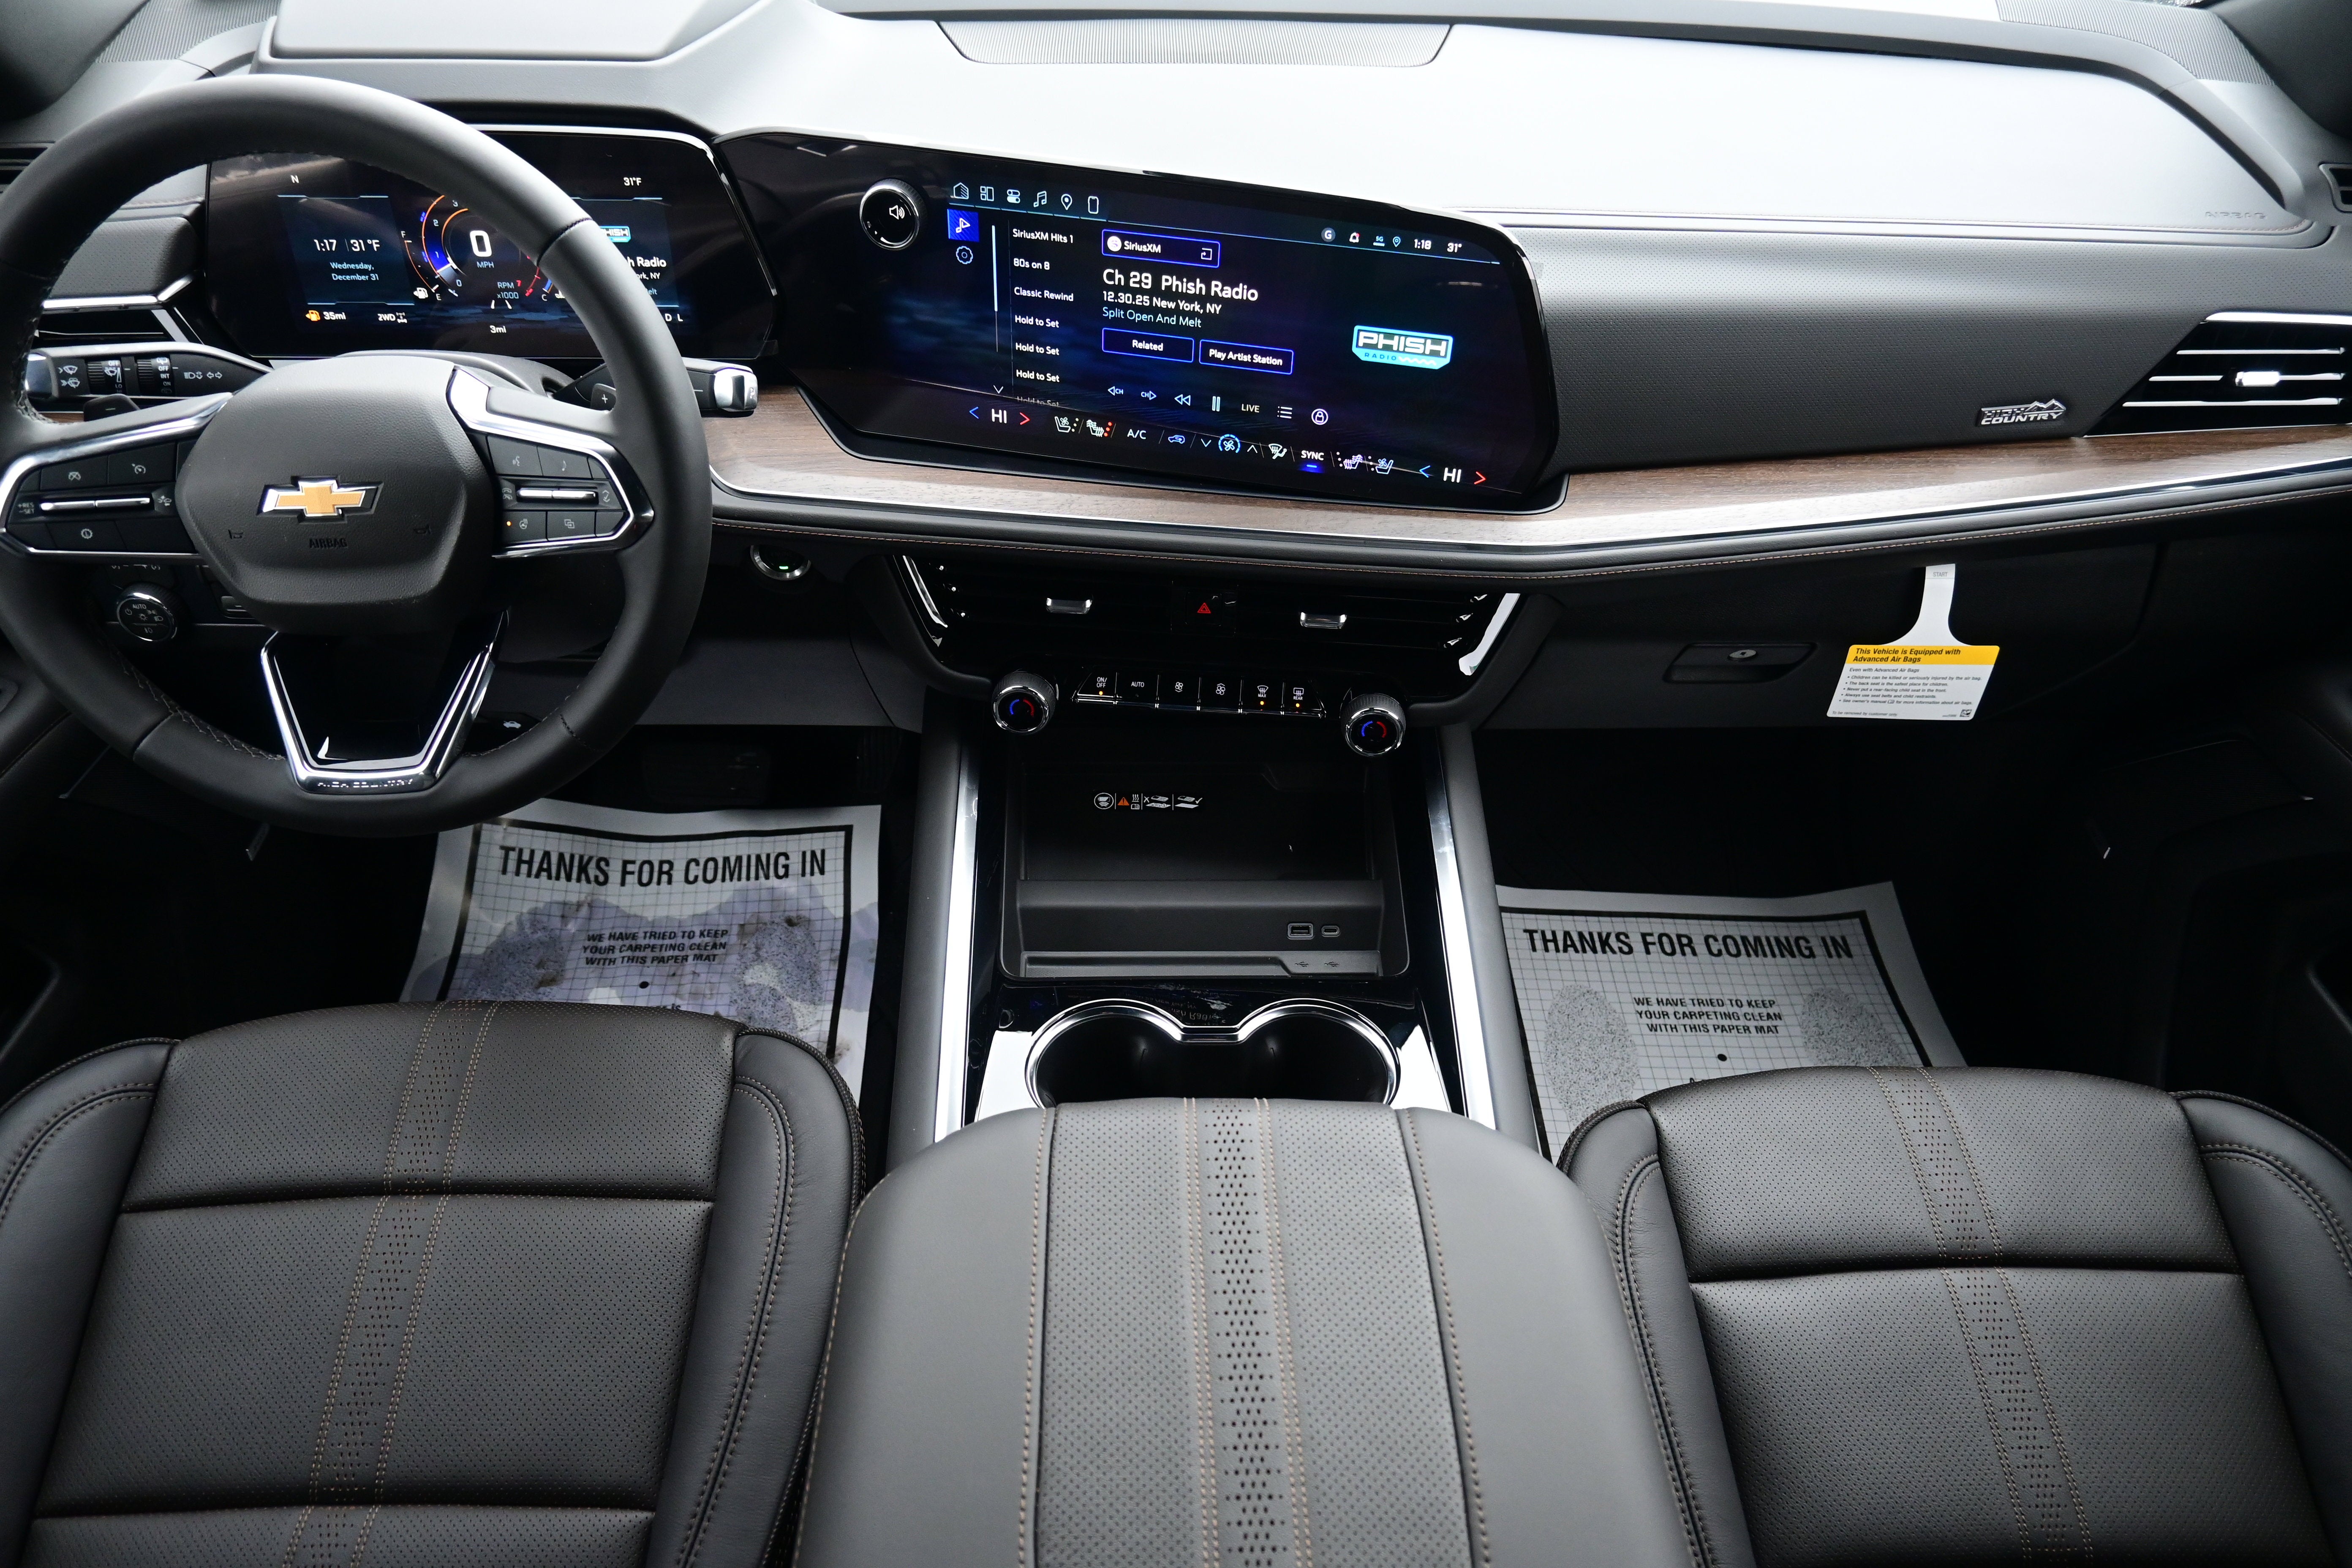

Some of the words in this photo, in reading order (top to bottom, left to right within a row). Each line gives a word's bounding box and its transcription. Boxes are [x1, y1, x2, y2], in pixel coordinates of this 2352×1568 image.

[291, 175, 299, 183] N
[623, 177, 641, 185] 31°F
[1013, 229, 1048, 240] SiriusXM
[1051, 233, 1067, 242] Hits
[1070, 235, 1073, 243] 1
[1325, 229, 1332, 239] G
[314, 240, 336, 251] 1:17
[470, 230, 492, 257] 0
[1124, 241, 1161, 253] SiriusXM
[1415, 239, 1431, 249] 1:18
[1447, 243, 1462, 252] 31°
[330, 262, 374, 271] Wednesday,
[637, 256, 666, 267] Radio
[1014, 258, 1029, 267] 80s
[1044, 261, 1050, 270] 8
[1103, 269, 1124, 286] Ch
[1130, 272, 1152, 289] 29
[1162, 275, 1205, 295] Phish
[1211, 281, 1258, 301] Radio
[1014, 287, 1042, 297] Classic
[1044, 290, 1073, 301] Rewind
[1103, 291, 1149, 306] 12.30.25
[1153, 297, 1176, 309] New
[1178, 300, 1203, 313] York,
[1206, 303, 1222, 314] NY
[323, 312, 346, 320] 35mi
[1015, 315, 1033, 324] Hold
[1046, 318, 1059, 328] Set
[1103, 307, 1124, 319] Split
[1127, 310, 1153, 322] Open
[1156, 313, 1176, 324] And
[1179, 316, 1201, 327] Melt
[1016, 343, 1034, 352] Hold
[1046, 346, 1059, 355] Set
[1132, 340, 1163, 351] Related
[1358, 331, 1447, 357] PHISH
[1209, 349, 1226, 360] Play
[1228, 351, 1251, 362] Artist
[1253, 354, 1282, 365] Station
[1364, 352, 1397, 361] RADIO
[1016, 370, 1034, 379] Hold
[1047, 373, 1059, 382] Set
[1242, 404, 1259, 413] LIVE
[992, 409, 1007, 423] HI
[1981, 412, 2063, 425] COUNTRY
[1127, 429, 1146, 439] A/C
[1301, 450, 1324, 460] SYNC
[1443, 468, 1461, 483] HI
[309, 538, 348, 548] AIRBAG
[500, 845, 610, 886] THANKS
[620, 859, 674, 887] FOR
[684, 852, 790, 885] COMING
[801, 849, 825, 877] IN
[587, 933, 605, 942] WE
[608, 932, 639, 941] HAVE
[643, 931, 676, 940] TRIED
[681, 930, 696, 939] TO
[699, 929, 728, 939] KEEP
[583, 945, 615, 955] YOUR
[619, 943, 685, 953] CARPETING
[689, 942, 727, 951] CLEAN
[1523, 929, 1633, 955] THANKS
[1641, 931, 1698, 956] FOR
[1704, 934, 1816, 958] COMING
[1821, 935, 1853, 958] IN
[585, 957, 616, 966] WITH
[621, 956, 647, 965] THIS
[651, 954, 689, 964] PAPER
[693, 953, 718, 962] MAT
[1634, 997, 1653, 1006] WE
[1656, 997, 1687, 1007] HAVE
[1690, 998, 1724, 1007] TRIED
[1727, 999, 1743, 1008] TO
[1747, 999, 1775, 1009] KEEP
[1636, 1010, 1670, 1020] YOUR
[1674, 1011, 1740, 1021] CARPETING
[1744, 1012, 1782, 1021] CLEAN
[1647, 1024, 1678, 1033] WITH
[1682, 1024, 1710, 1033] THIS
[1713, 1024, 1752, 1034] PAPER
[1755, 1025, 1780, 1034] MAT
